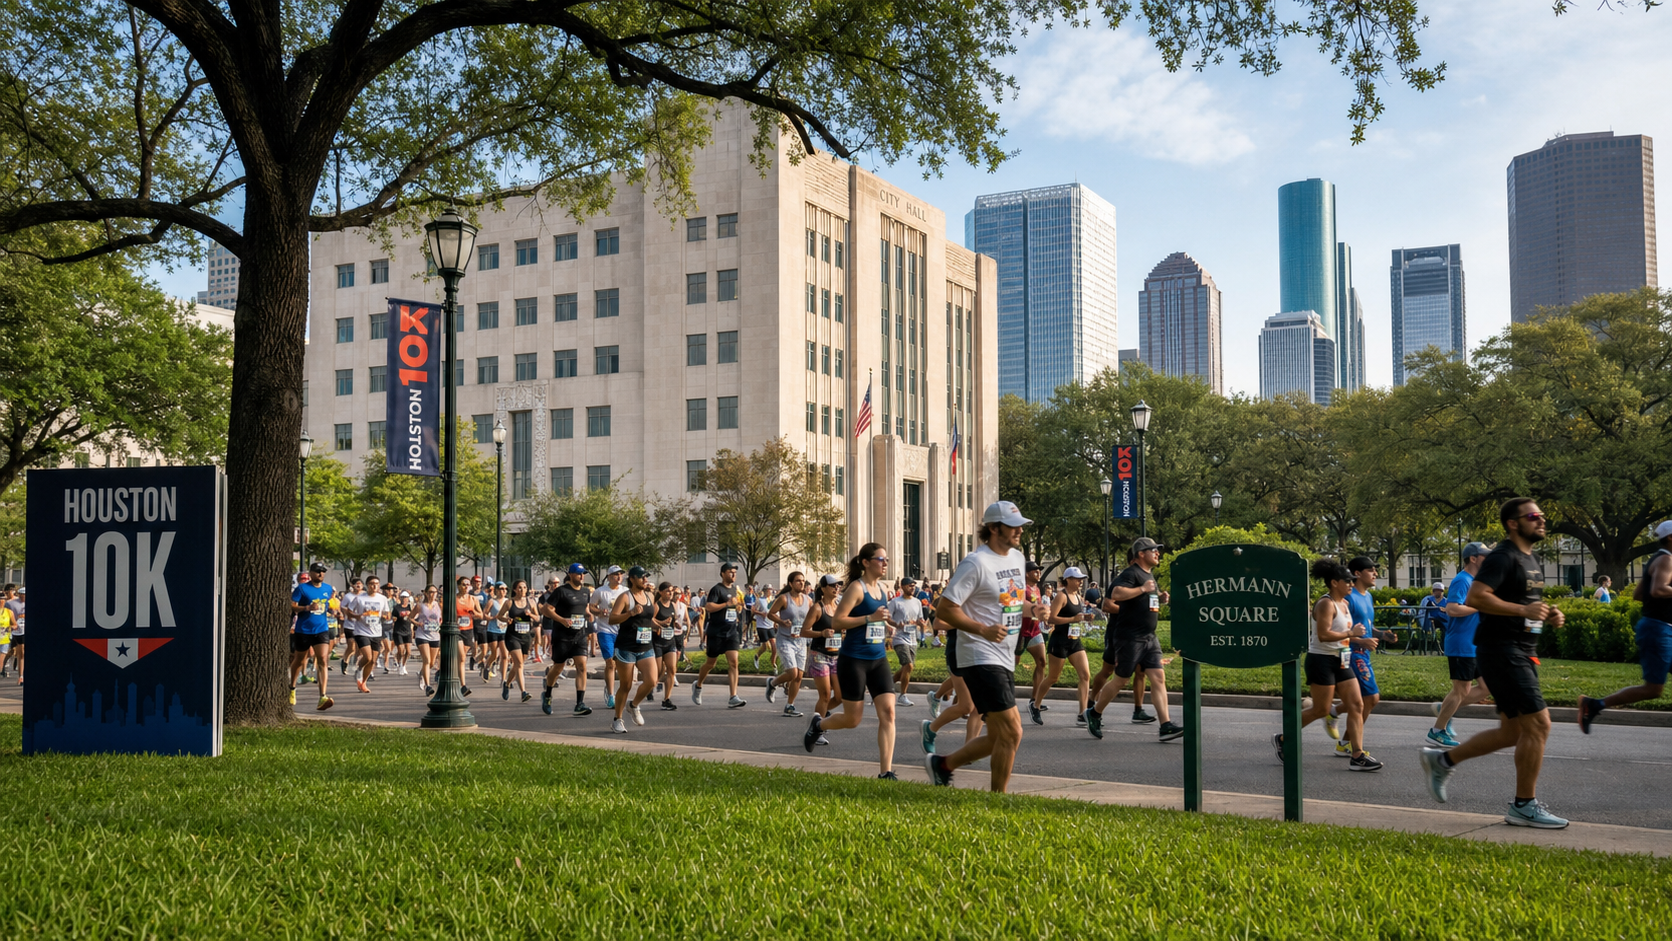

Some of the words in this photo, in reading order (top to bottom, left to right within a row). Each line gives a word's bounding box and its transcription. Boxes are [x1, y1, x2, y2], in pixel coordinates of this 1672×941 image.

[880, 189, 900, 208] CITY
[906, 202, 927, 222] HALL
[399, 305, 429, 386] 10K
[1118, 447, 1132, 480] 10K
[64, 486, 177, 523] HOUSTON
[65, 531, 177, 630] 10K
[1186, 577, 1292, 600] HERMANN
[1198, 606, 1280, 626] SQUARE
[1210, 635, 1237, 646] EST.
[1241, 635, 1268, 647] 1870
